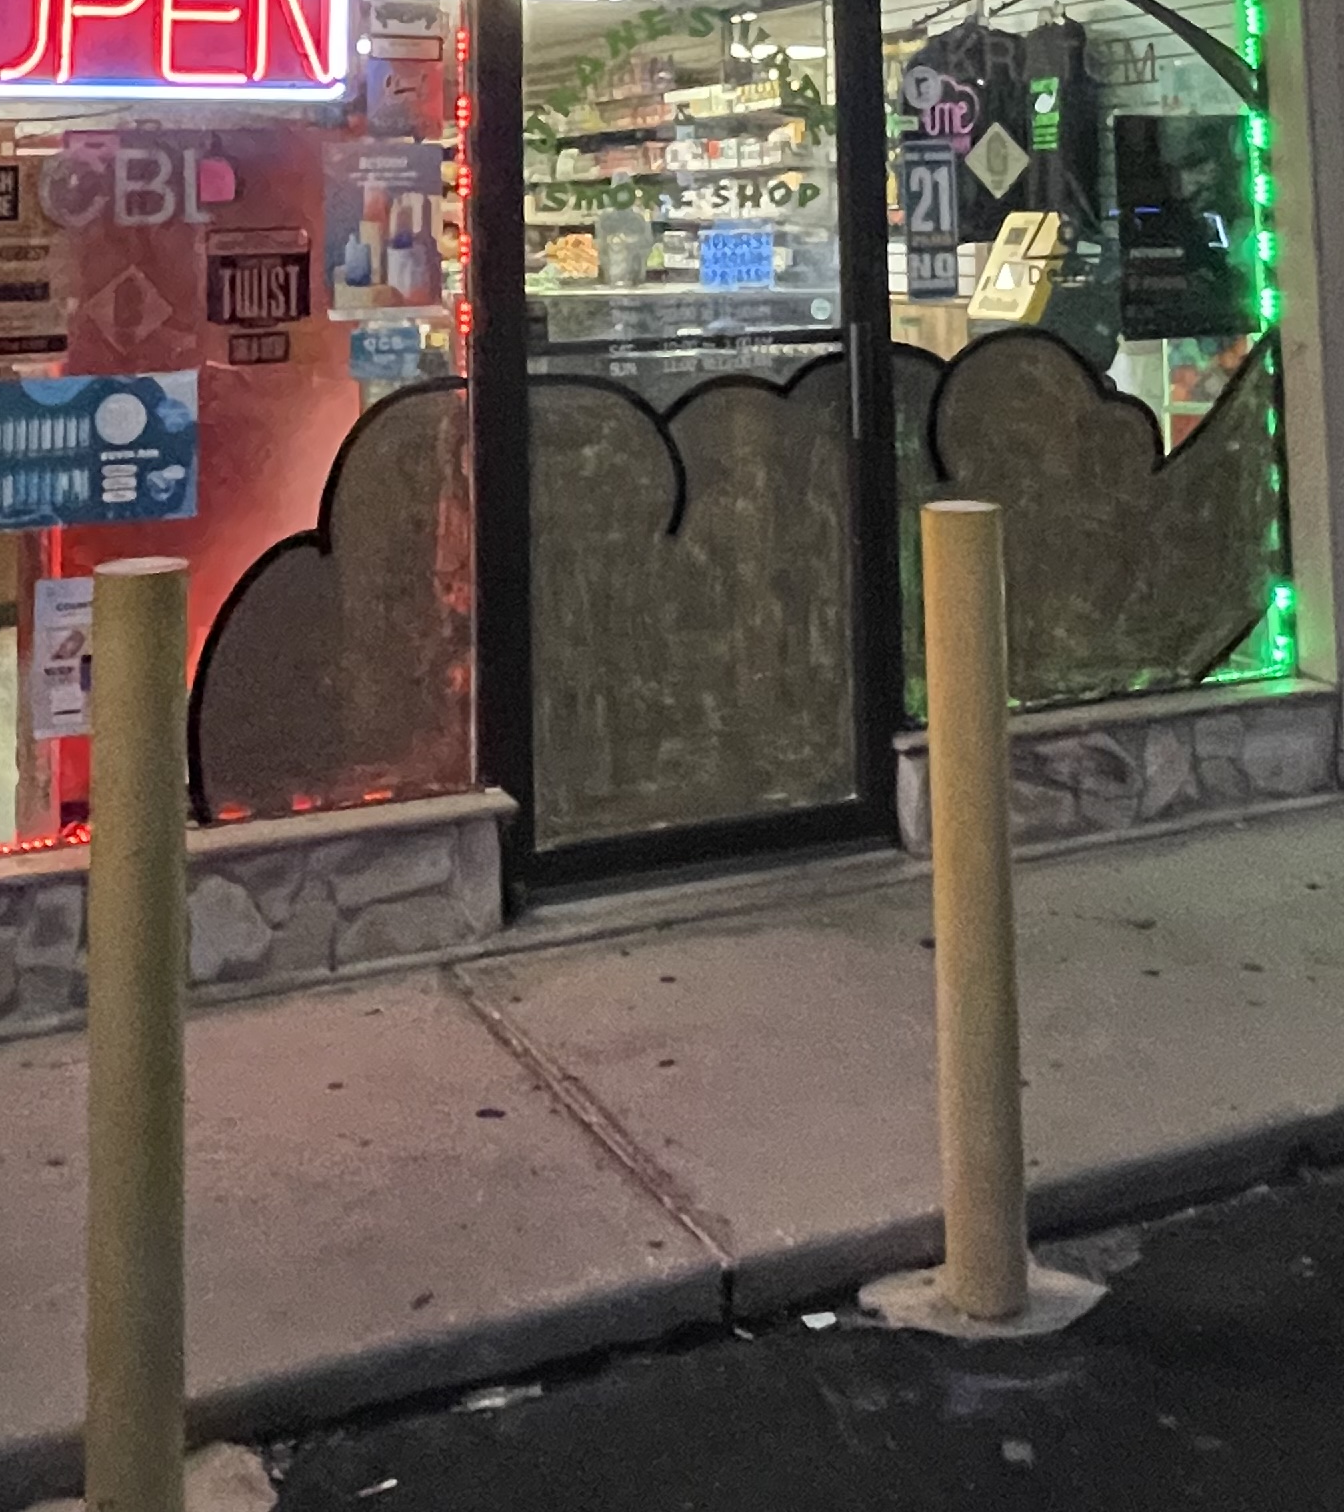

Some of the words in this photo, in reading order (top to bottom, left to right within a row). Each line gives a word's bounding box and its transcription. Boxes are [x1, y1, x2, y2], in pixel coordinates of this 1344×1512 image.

[711, 181, 821, 210] SHOP
[909, 166, 952, 233] 21
[908, 253, 955, 279] NO
[219, 264, 301, 320] TWIST
